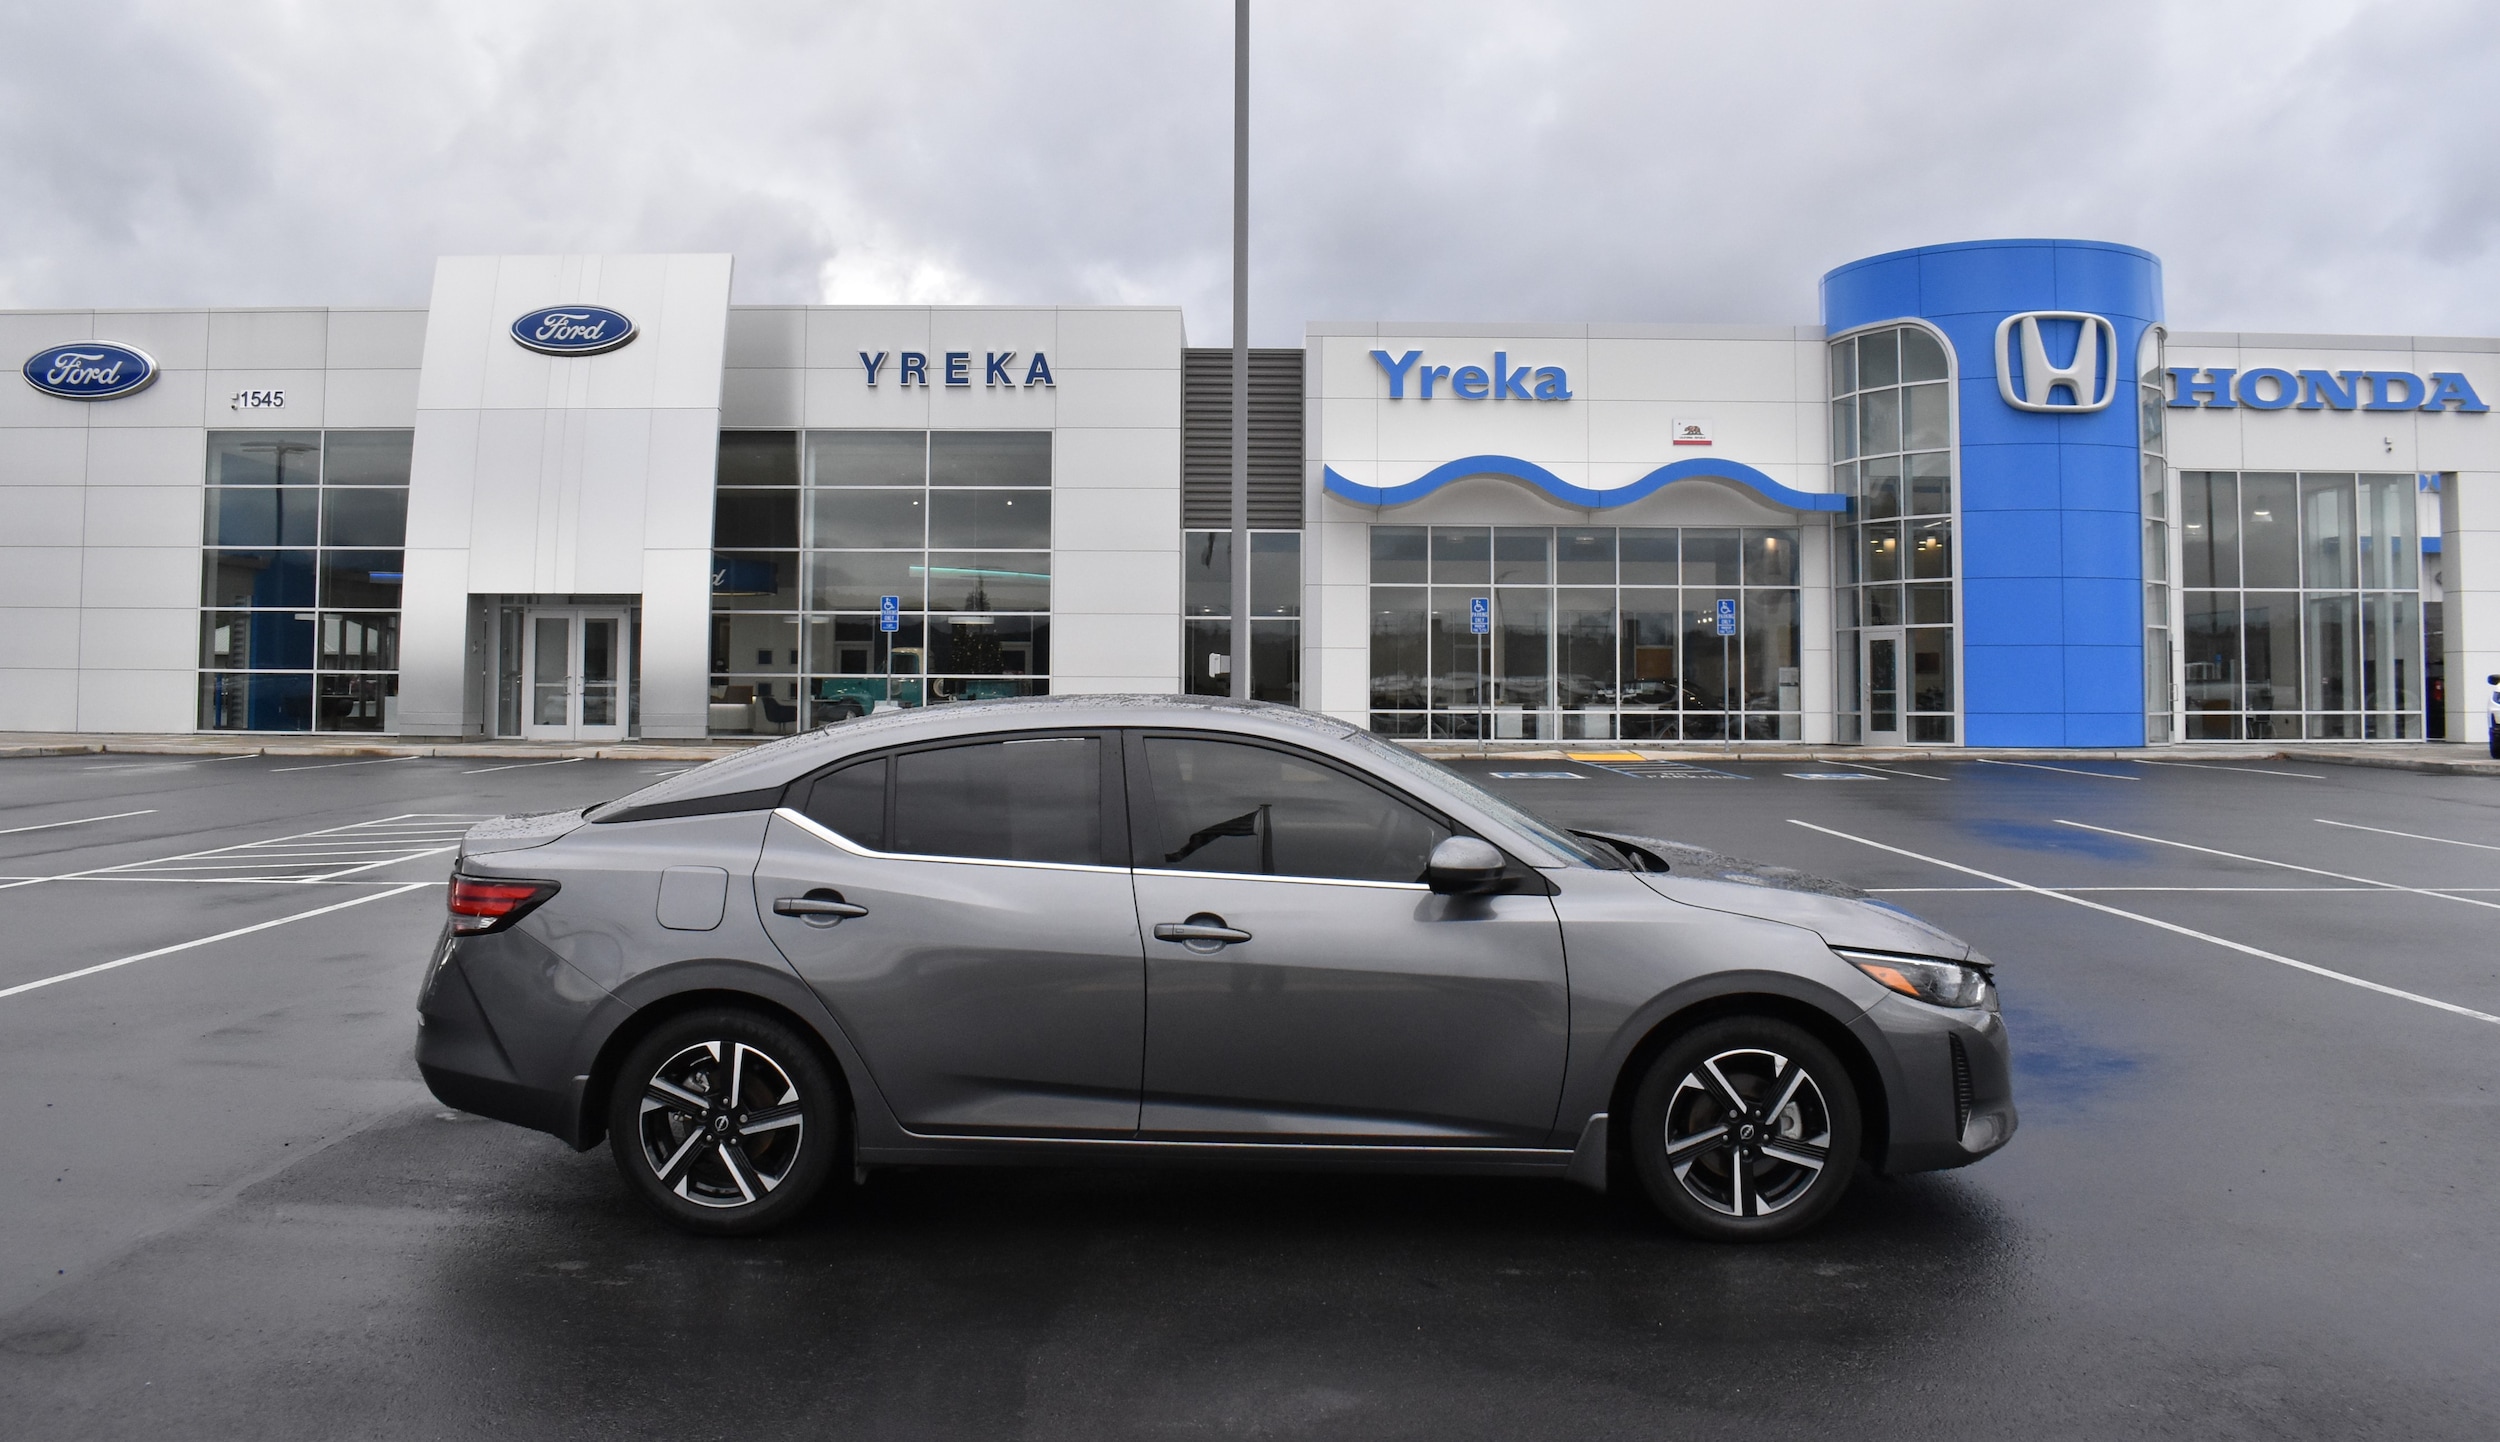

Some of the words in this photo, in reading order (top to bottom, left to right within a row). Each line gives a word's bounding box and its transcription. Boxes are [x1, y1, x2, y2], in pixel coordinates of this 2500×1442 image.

[538, 313, 606, 341] Ford
[47, 353, 122, 385] Ford
[858, 350, 1056, 387] YREKA
[1369, 350, 1573, 400] Yreka
[241, 391, 284, 407] 1545
[2166, 367, 2490, 412] HONDA
